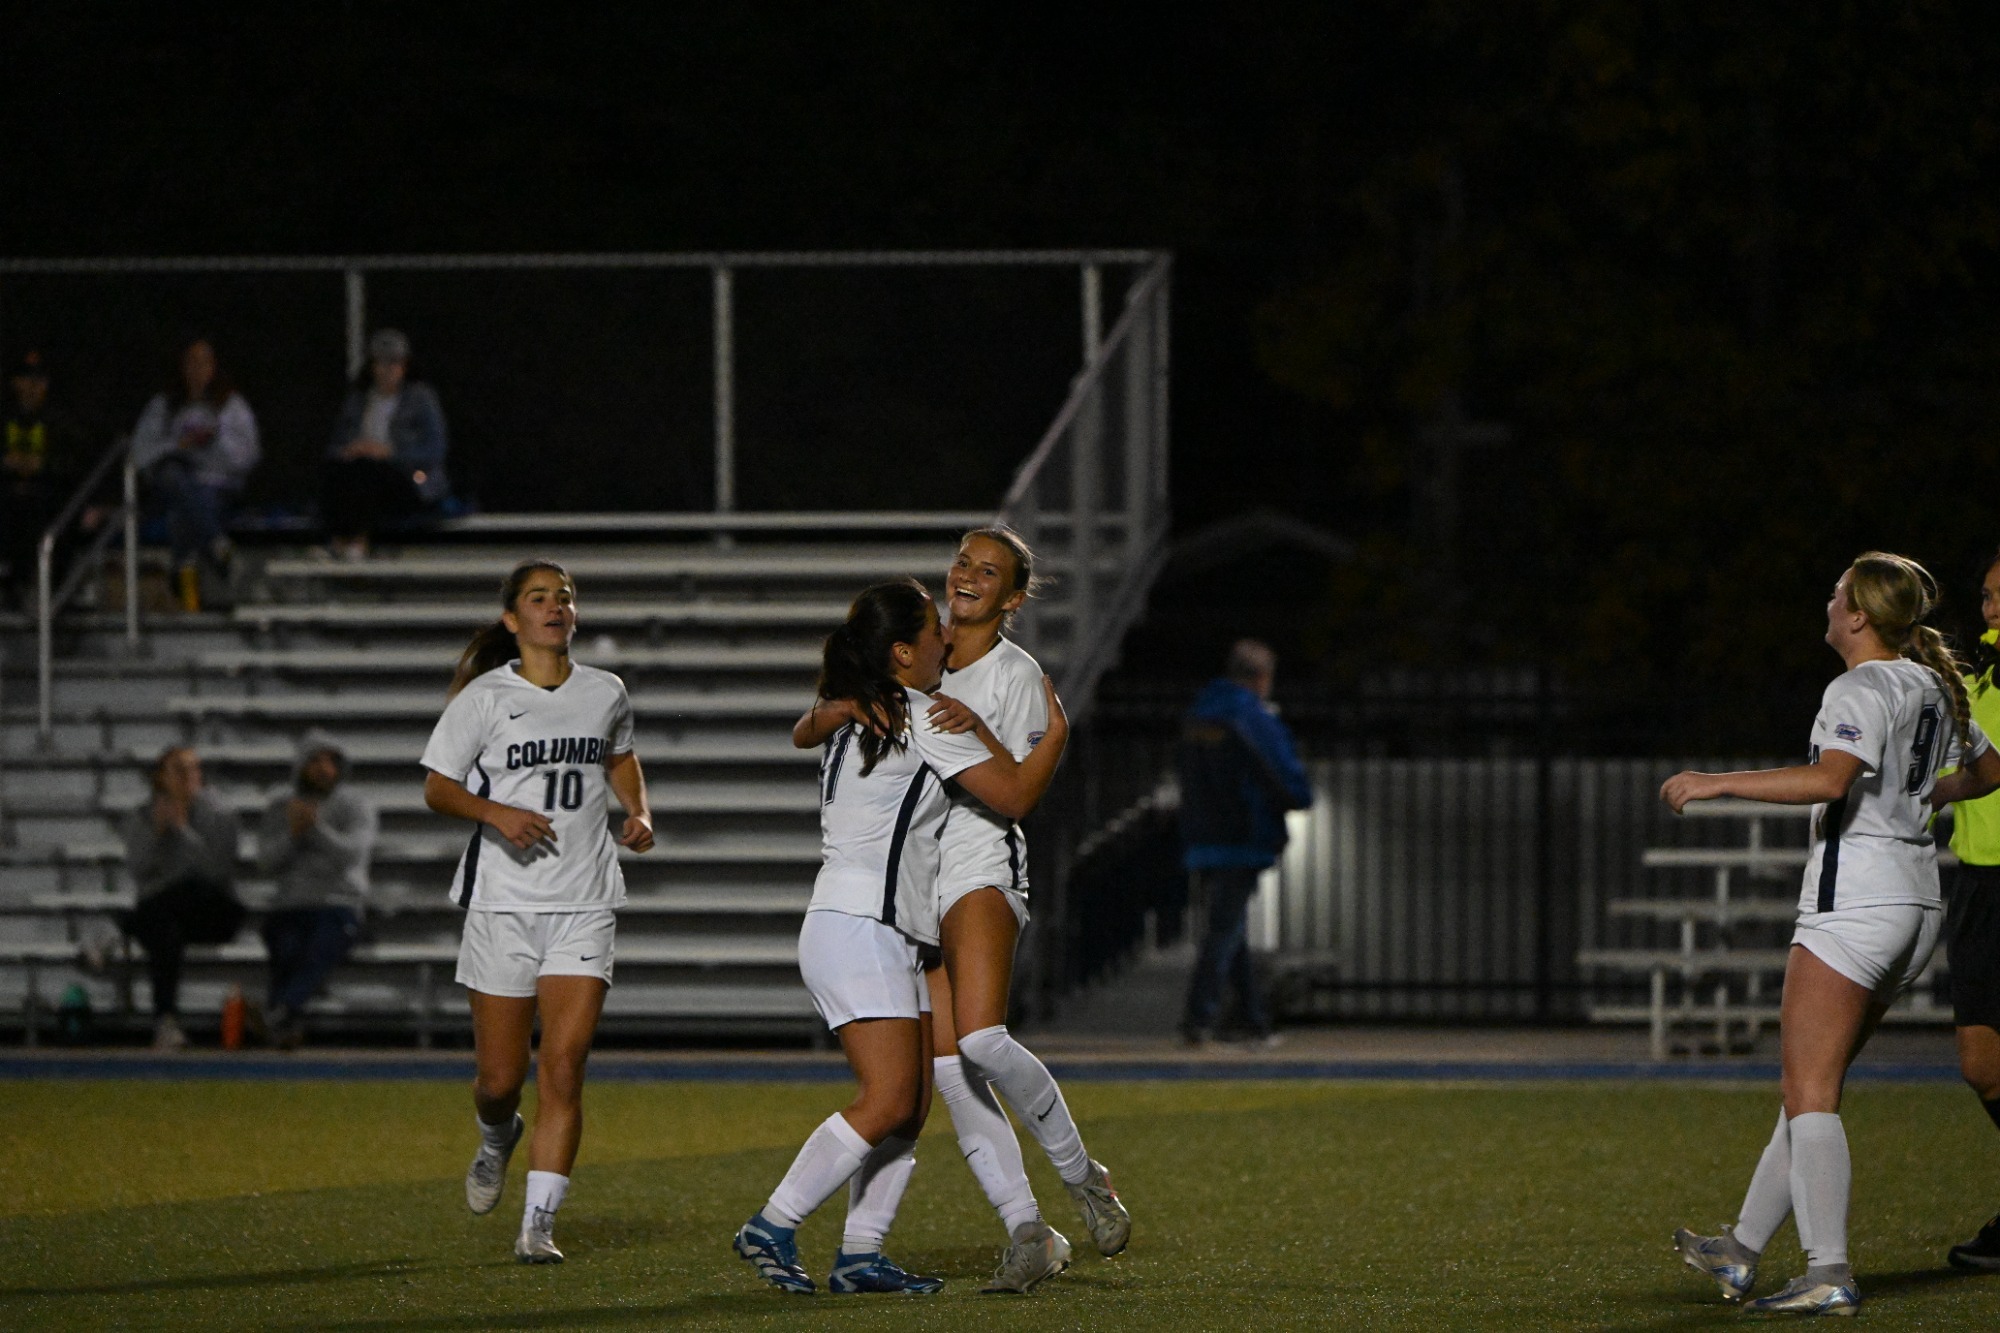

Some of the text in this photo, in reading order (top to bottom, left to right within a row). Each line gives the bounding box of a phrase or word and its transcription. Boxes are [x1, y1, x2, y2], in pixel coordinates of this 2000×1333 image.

[506, 737, 606, 770] COLUMBI
[1906, 703, 1942, 797] 9
[542, 768, 584, 812] 10
